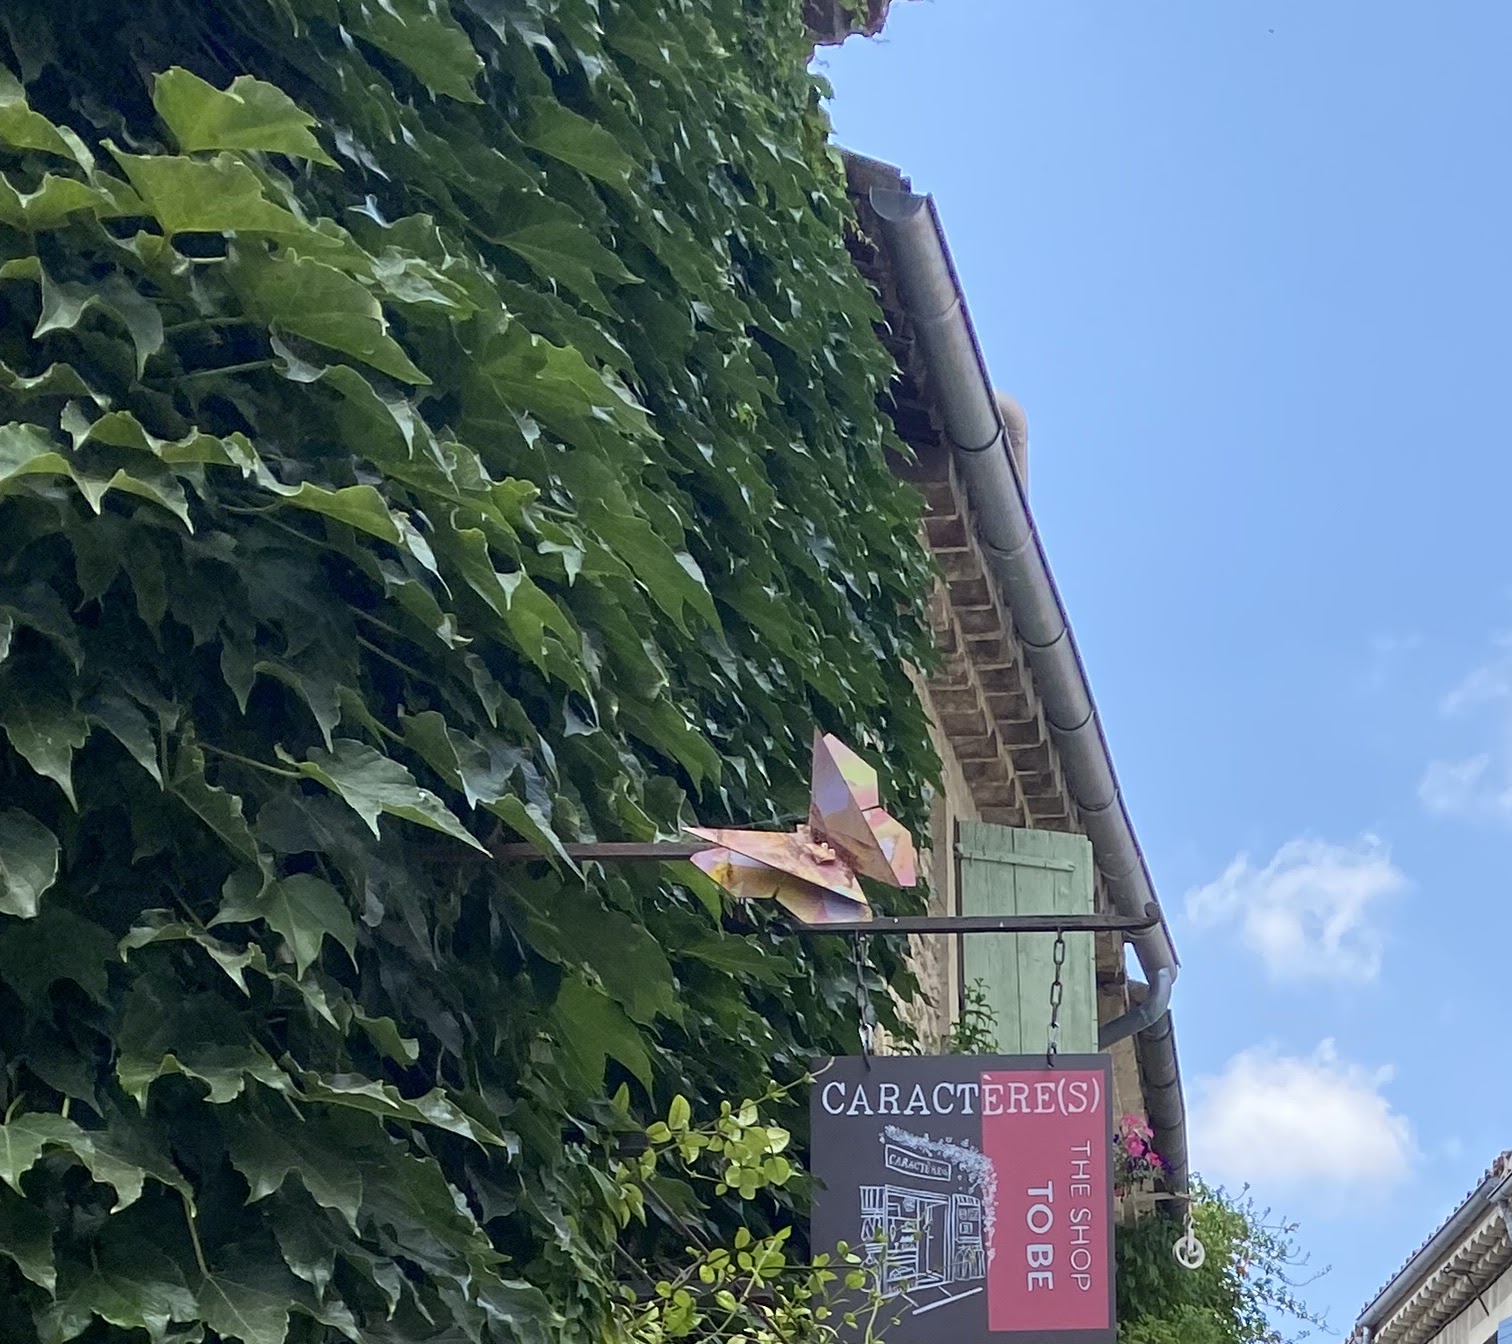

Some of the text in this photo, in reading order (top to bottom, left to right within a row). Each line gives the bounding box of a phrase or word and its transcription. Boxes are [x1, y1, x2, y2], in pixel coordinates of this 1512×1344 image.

[822, 1073, 1100, 1117] CARACTÈRE(S)
[1026, 1180, 1054, 1292] TO BE
[1069, 1139, 1092, 1291] THE SHOP
